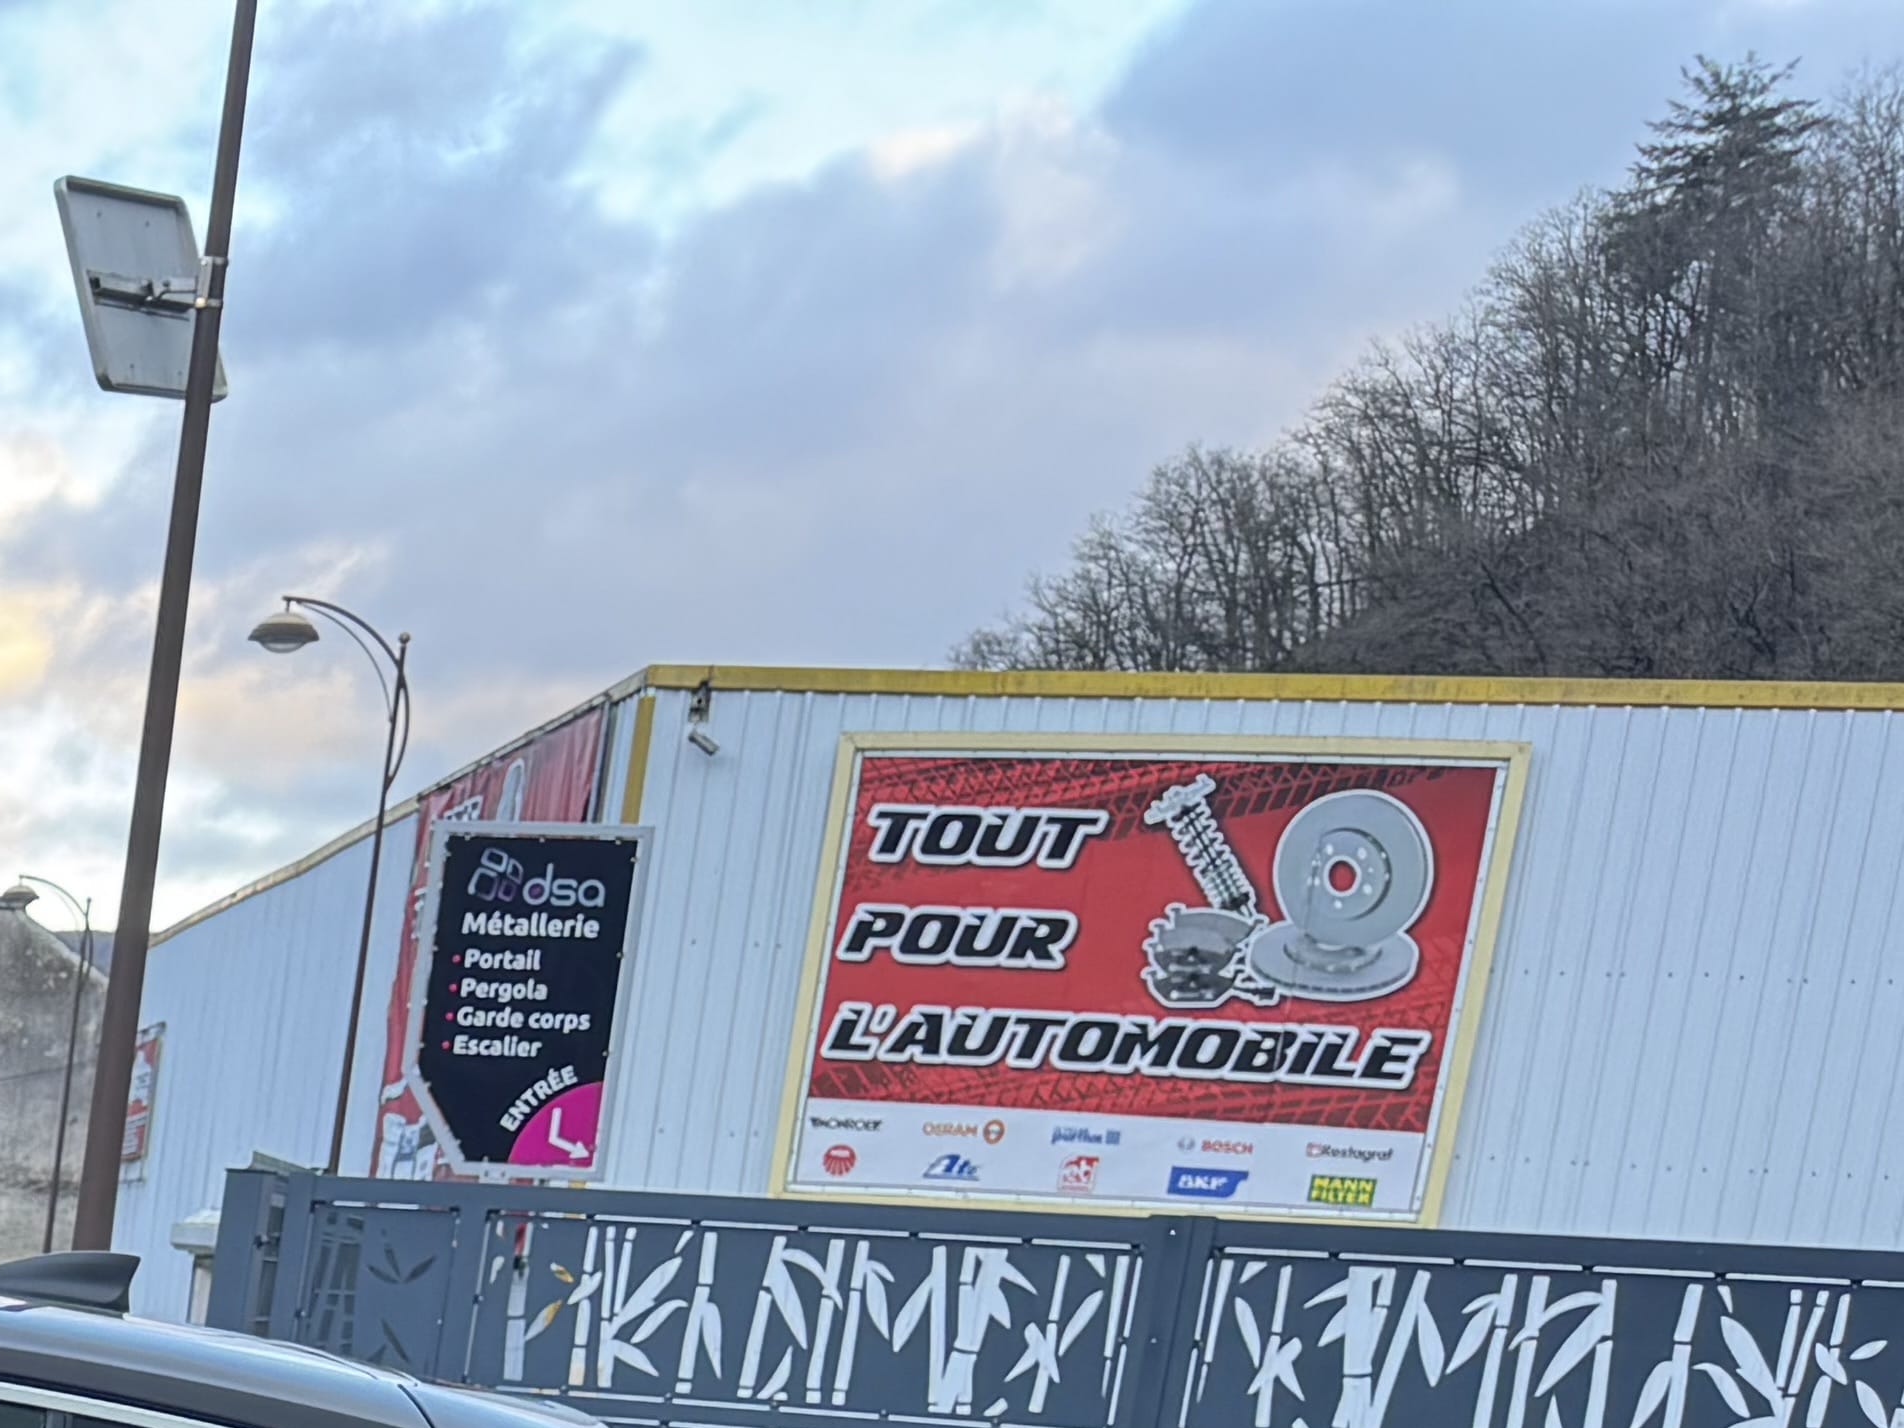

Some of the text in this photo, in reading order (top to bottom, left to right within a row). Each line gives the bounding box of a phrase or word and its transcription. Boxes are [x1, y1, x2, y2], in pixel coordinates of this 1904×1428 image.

[870, 805, 1107, 867] TOUT
[522, 863, 606, 908] dsa
[461, 912, 600, 938] Métallerie
[839, 905, 1076, 968] POUR
[464, 948, 541, 971] Portail
[460, 977, 548, 1004] Pergola
[456, 1006, 591, 1033] Garde corps
[453, 1035, 542, 1058] Escalier
[822, 1003, 1430, 1089] L'AUTOMOBILE
[499, 1065, 578, 1132] ENTRÉE
[922, 1121, 978, 1137] OSRAM
[1201, 1139, 1253, 1154] BOSCH
[1177, 1174, 1229, 1191] SKF
[1313, 1177, 1373, 1192] MANN
[1311, 1190, 1371, 1204] FILTER
